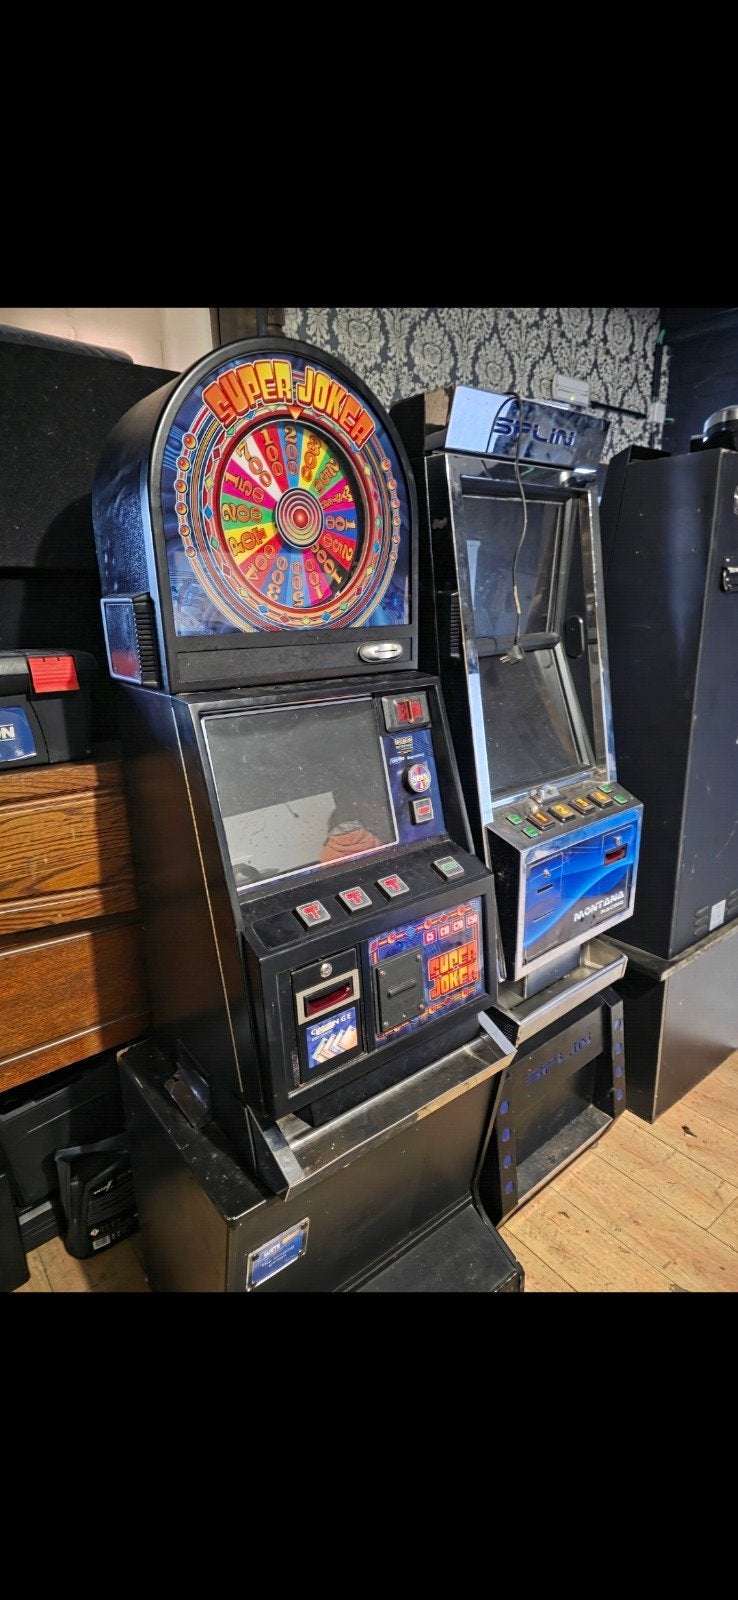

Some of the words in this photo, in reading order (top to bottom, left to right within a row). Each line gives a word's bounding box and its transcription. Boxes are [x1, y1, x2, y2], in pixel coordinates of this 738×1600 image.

[202, 359, 294, 430] SUPER
[296, 366, 376, 450] JOKER
[236, 438, 272, 487] 700
[260, 428, 284, 477] 100
[284, 425, 299, 475] 200
[225, 471, 264, 503] 150
[221, 503, 262, 523] 200
[326, 515, 356, 532] 100
[245, 544, 276, 580] 400
[266, 556, 289, 601] 300
[304, 558, 324, 599] 100
[291, 561, 304, 608] 500
[574, 890, 624, 921] MONTANA
[428, 940, 477, 980] SUPER
[430, 963, 479, 1000] JOKER
